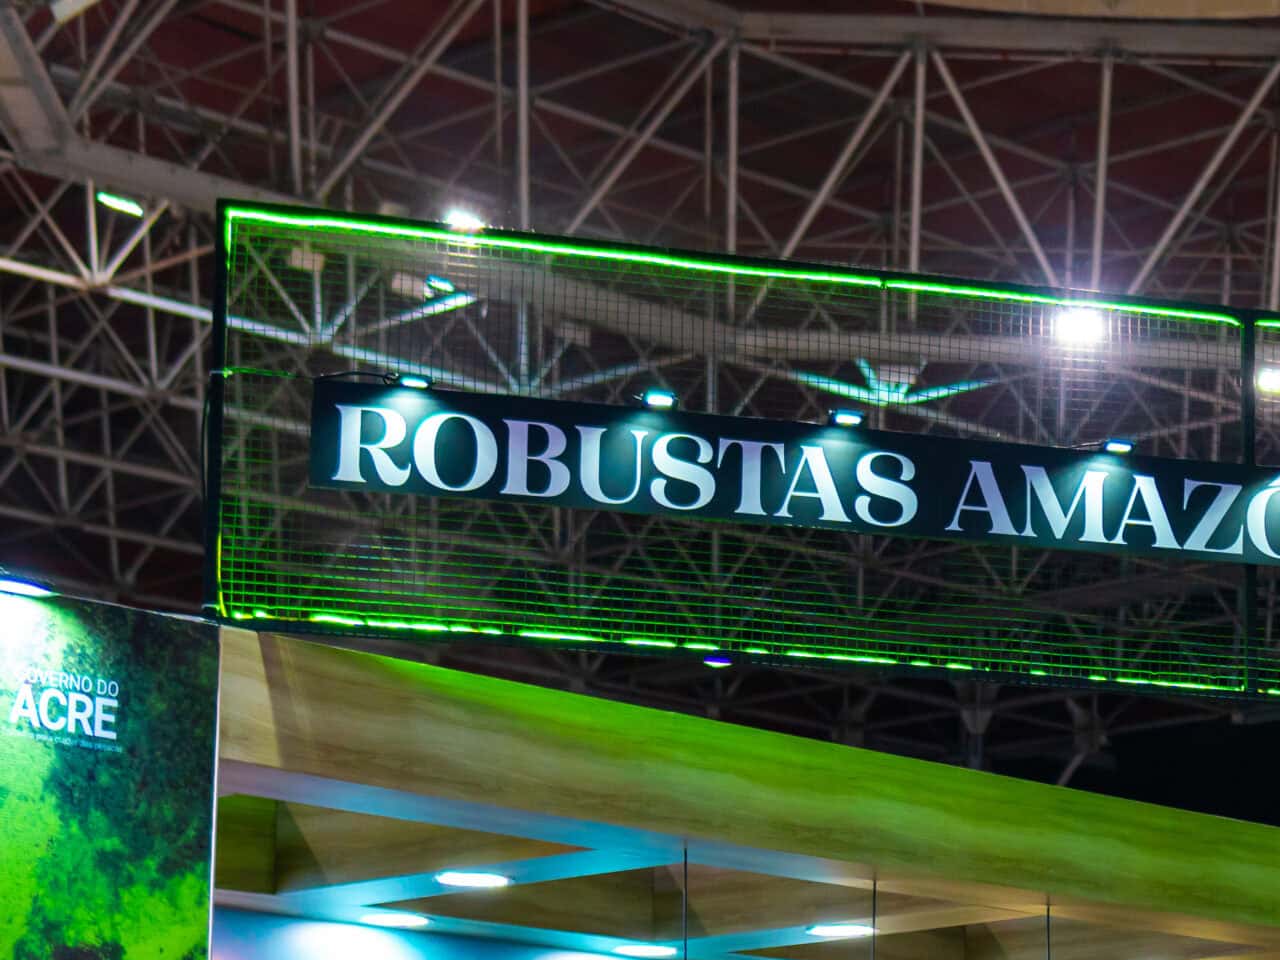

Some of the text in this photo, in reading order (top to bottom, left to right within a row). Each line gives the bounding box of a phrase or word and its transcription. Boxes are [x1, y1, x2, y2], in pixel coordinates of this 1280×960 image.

[331, 403, 918, 528] ROBUSTAS
[10, 682, 119, 740] ACRE
[16, 668, 119, 697] OVERNO DO
